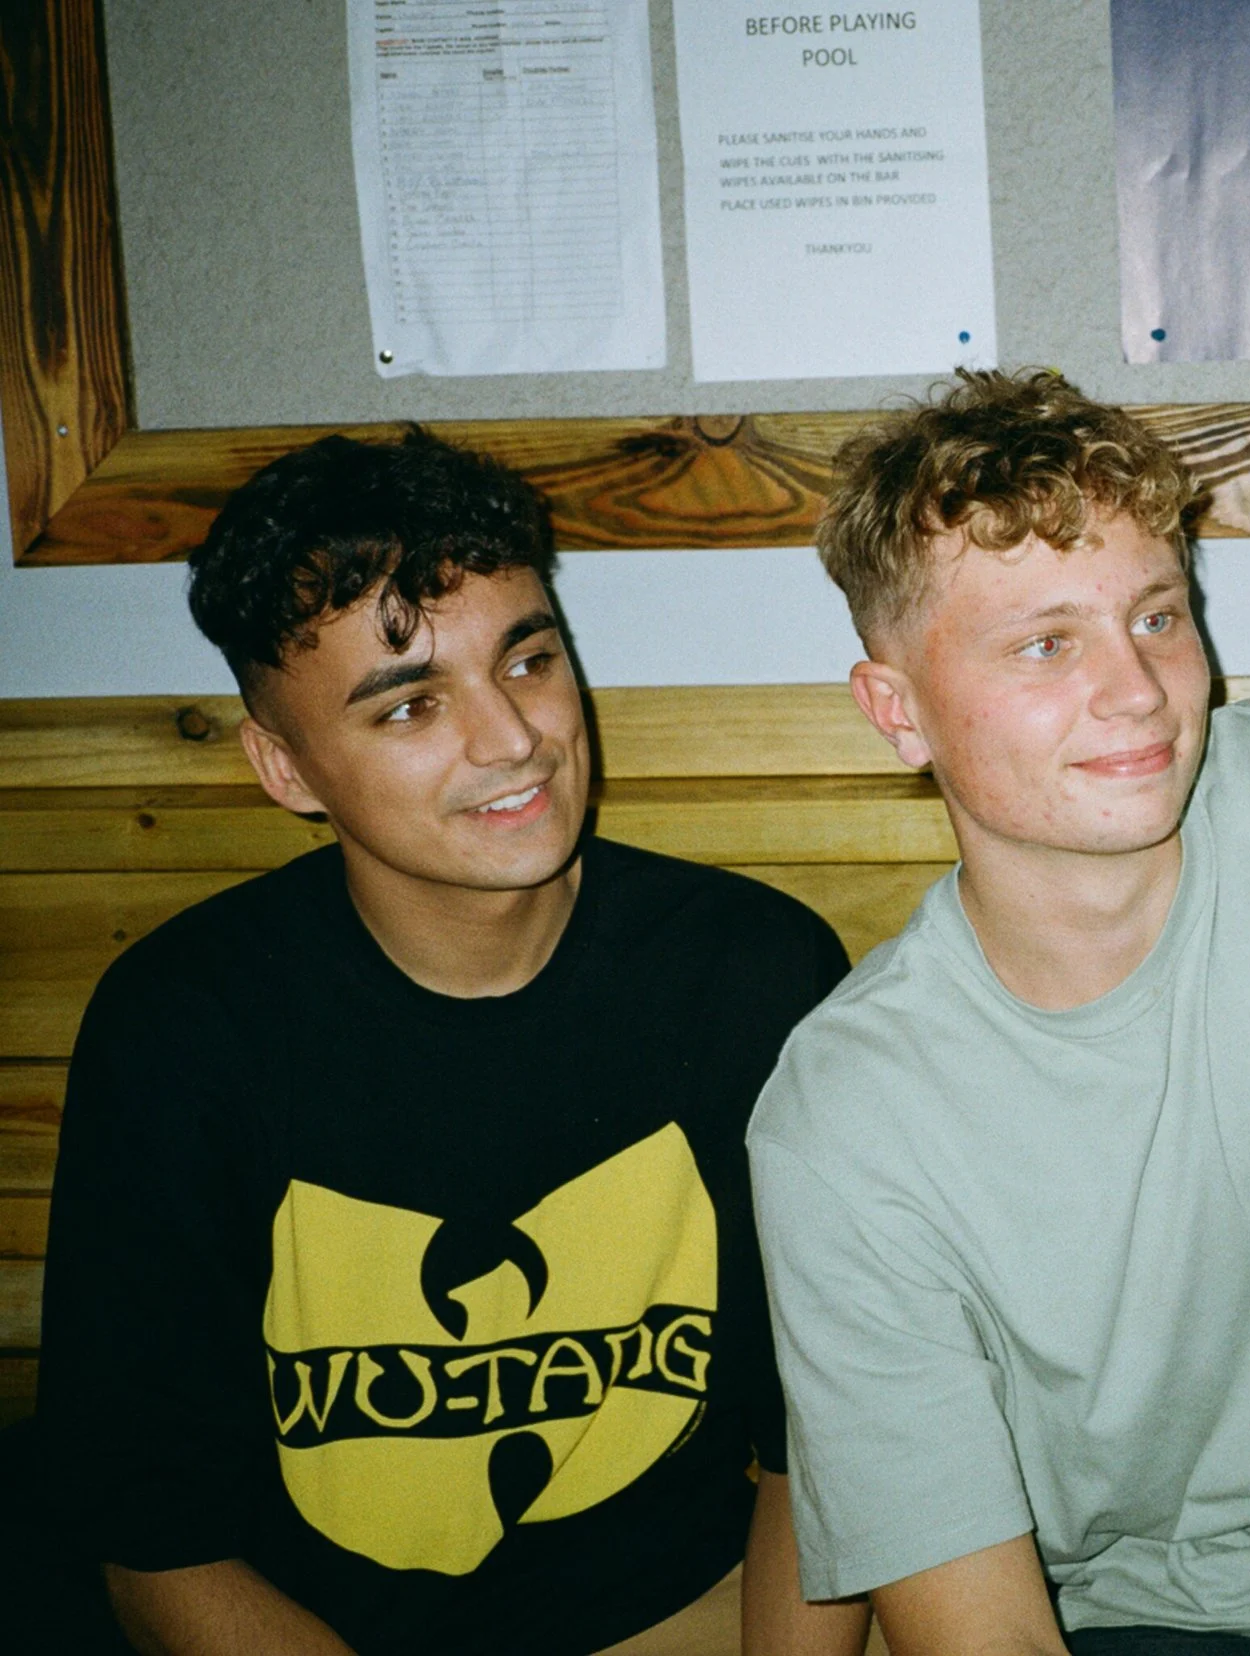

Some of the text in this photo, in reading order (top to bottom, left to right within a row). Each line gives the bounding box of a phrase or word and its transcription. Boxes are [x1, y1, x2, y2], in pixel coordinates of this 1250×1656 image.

[746, 11, 917, 36] BEFORE PLAYING
[802, 49, 858, 67] POOL
[718, 127, 927, 146] PLEASE SANITISE YOUR HANDS AND
[720, 150, 944, 169] WIPE THE CUES WITH THE SANITISING
[720, 170, 900, 188] WIPES AVAILABLE ON THE BAR
[720, 193, 937, 211] PLACE USED WIPES IN BIN PROVIDED
[266, 1314, 713, 1436] WU-TANG
